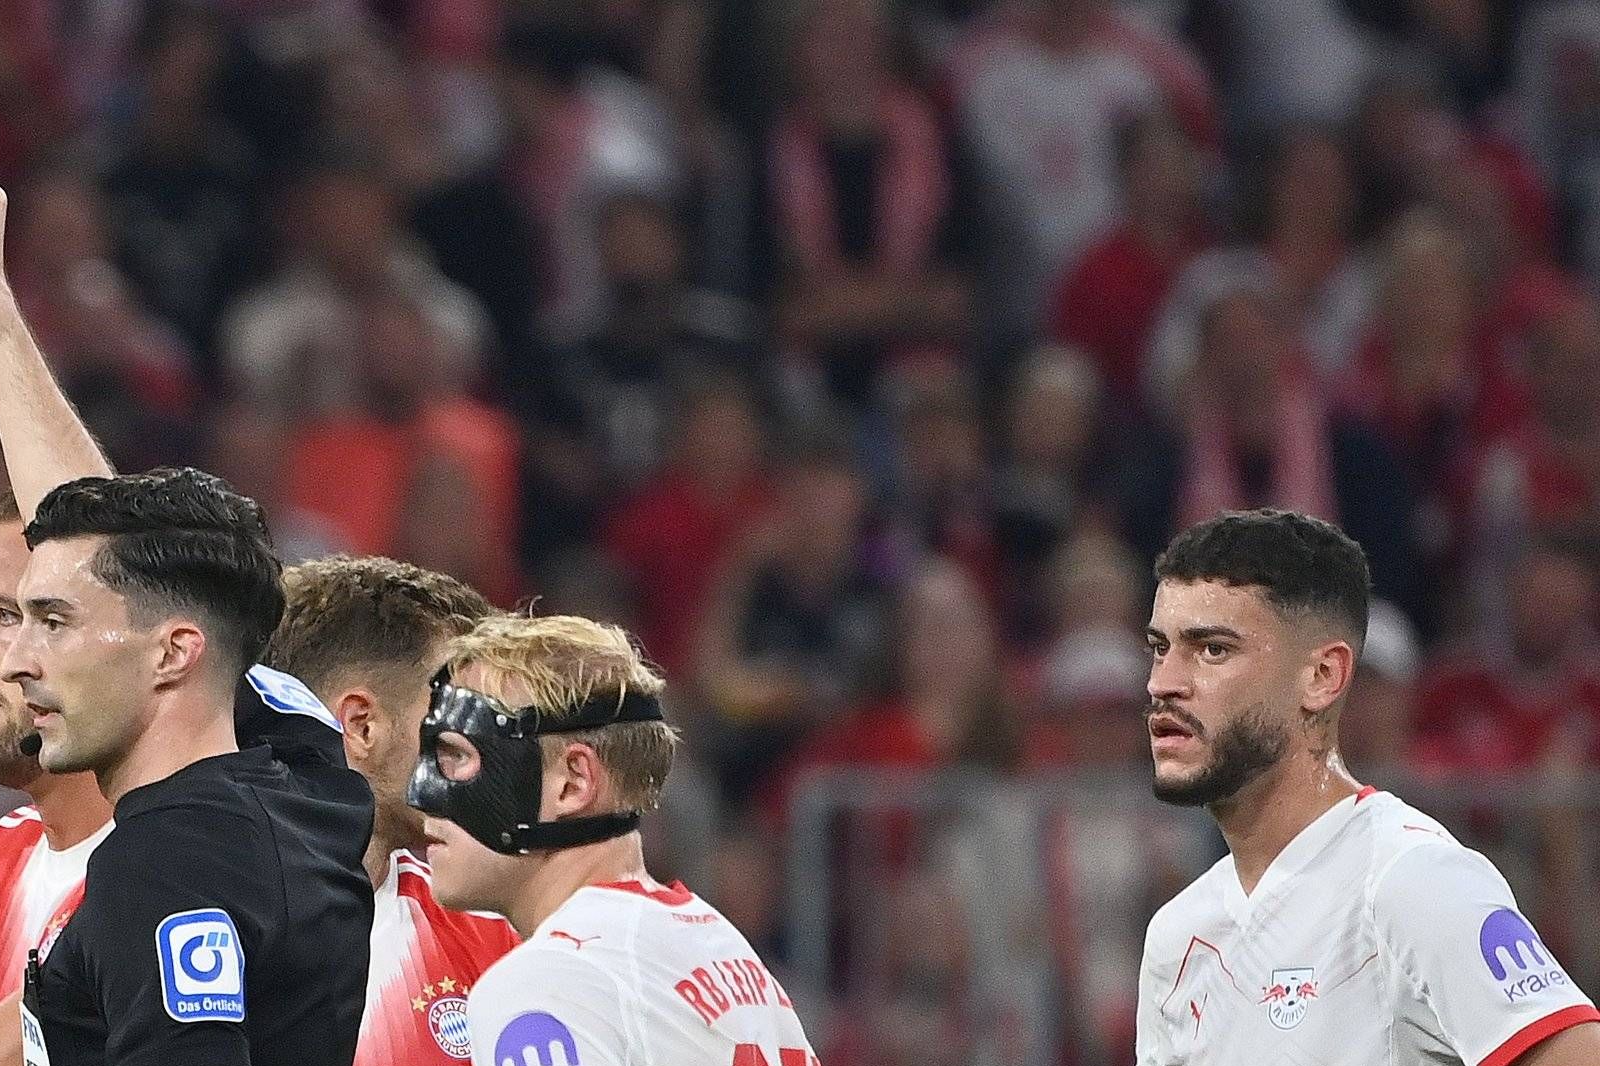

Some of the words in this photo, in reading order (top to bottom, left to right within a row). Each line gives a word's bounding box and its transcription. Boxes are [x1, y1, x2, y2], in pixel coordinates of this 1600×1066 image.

[674, 967, 731, 1027] RB
[177, 1001, 201, 1013] Das
[438, 1000, 470, 1015] BAYE
